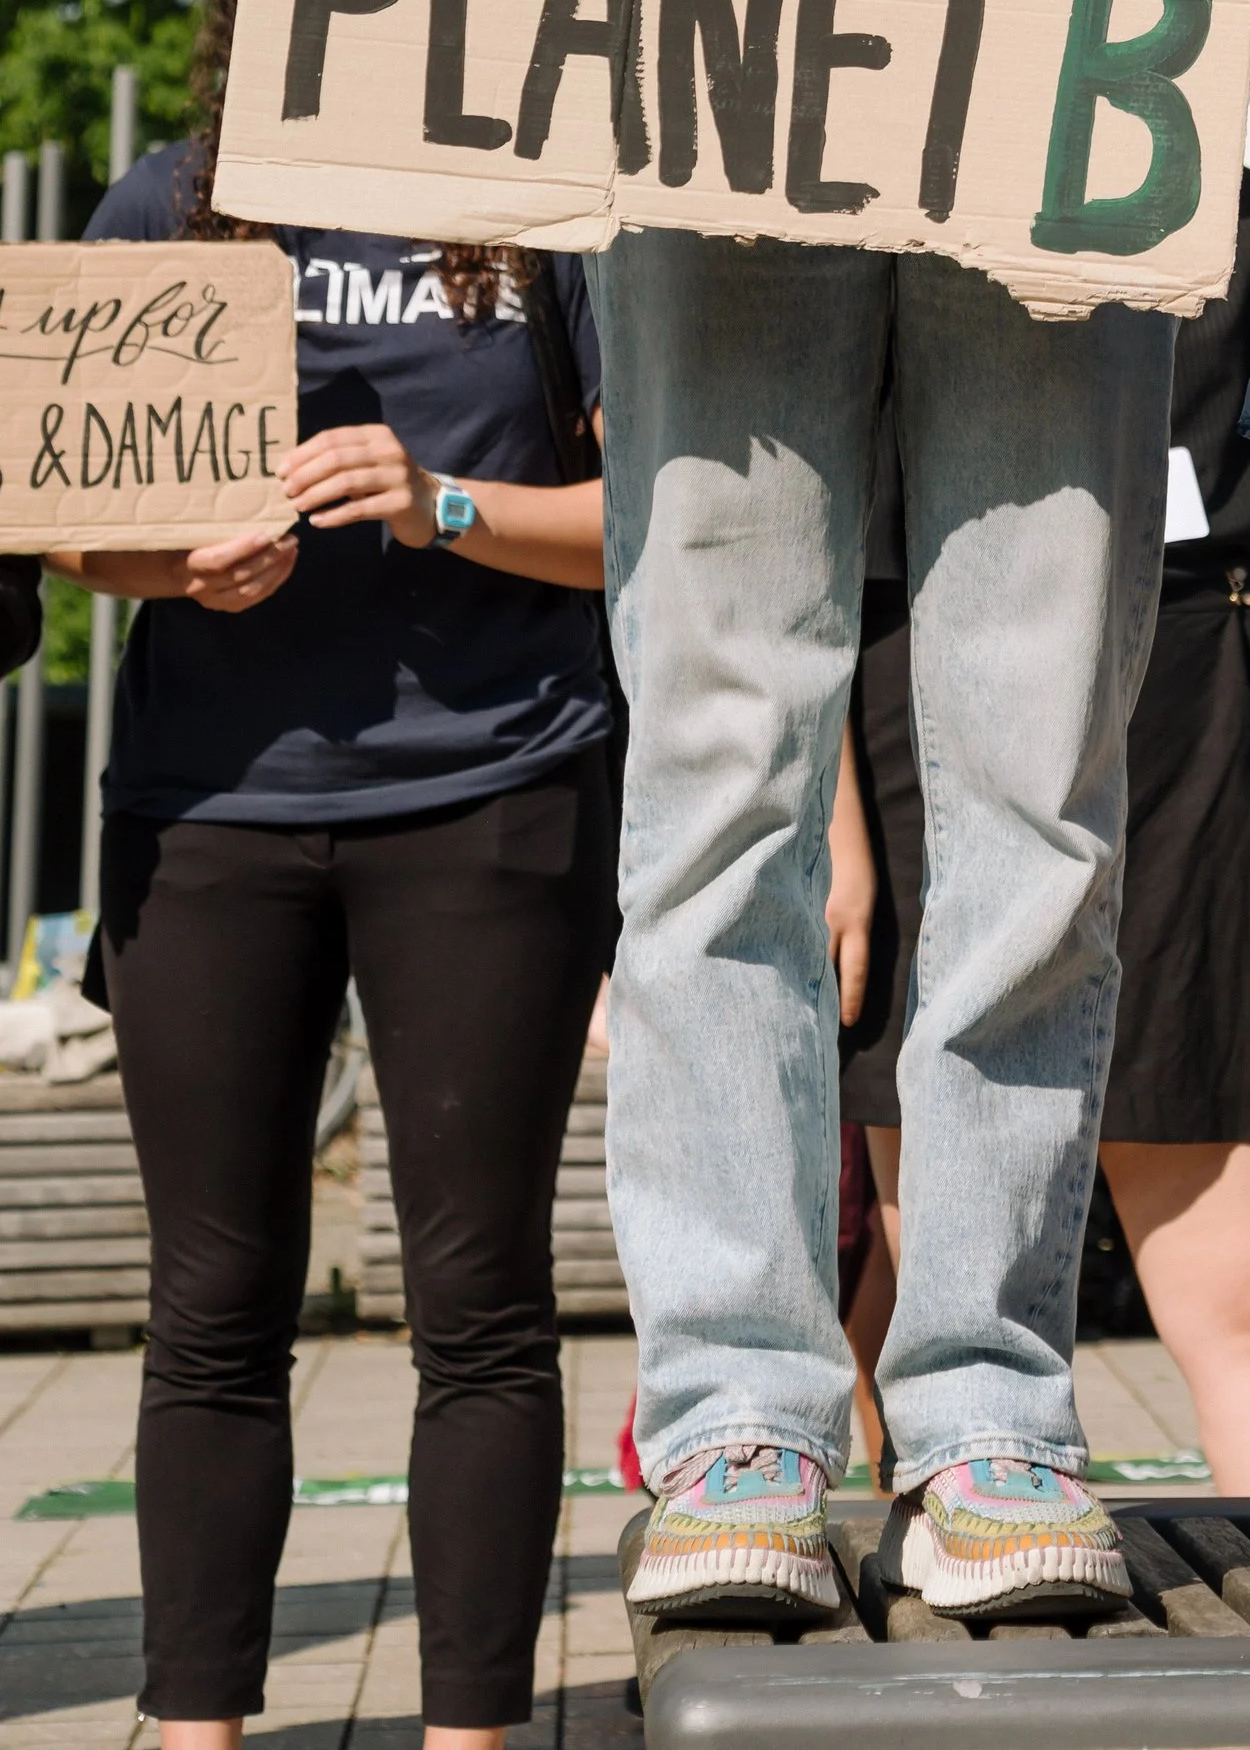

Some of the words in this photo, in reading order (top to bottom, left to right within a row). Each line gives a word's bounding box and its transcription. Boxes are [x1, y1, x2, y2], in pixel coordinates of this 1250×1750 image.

[20, 298, 122, 385] up
[111, 280, 228, 367] for
[30, 402, 71, 489] &
[80, 395, 281, 490] DAMAGE
